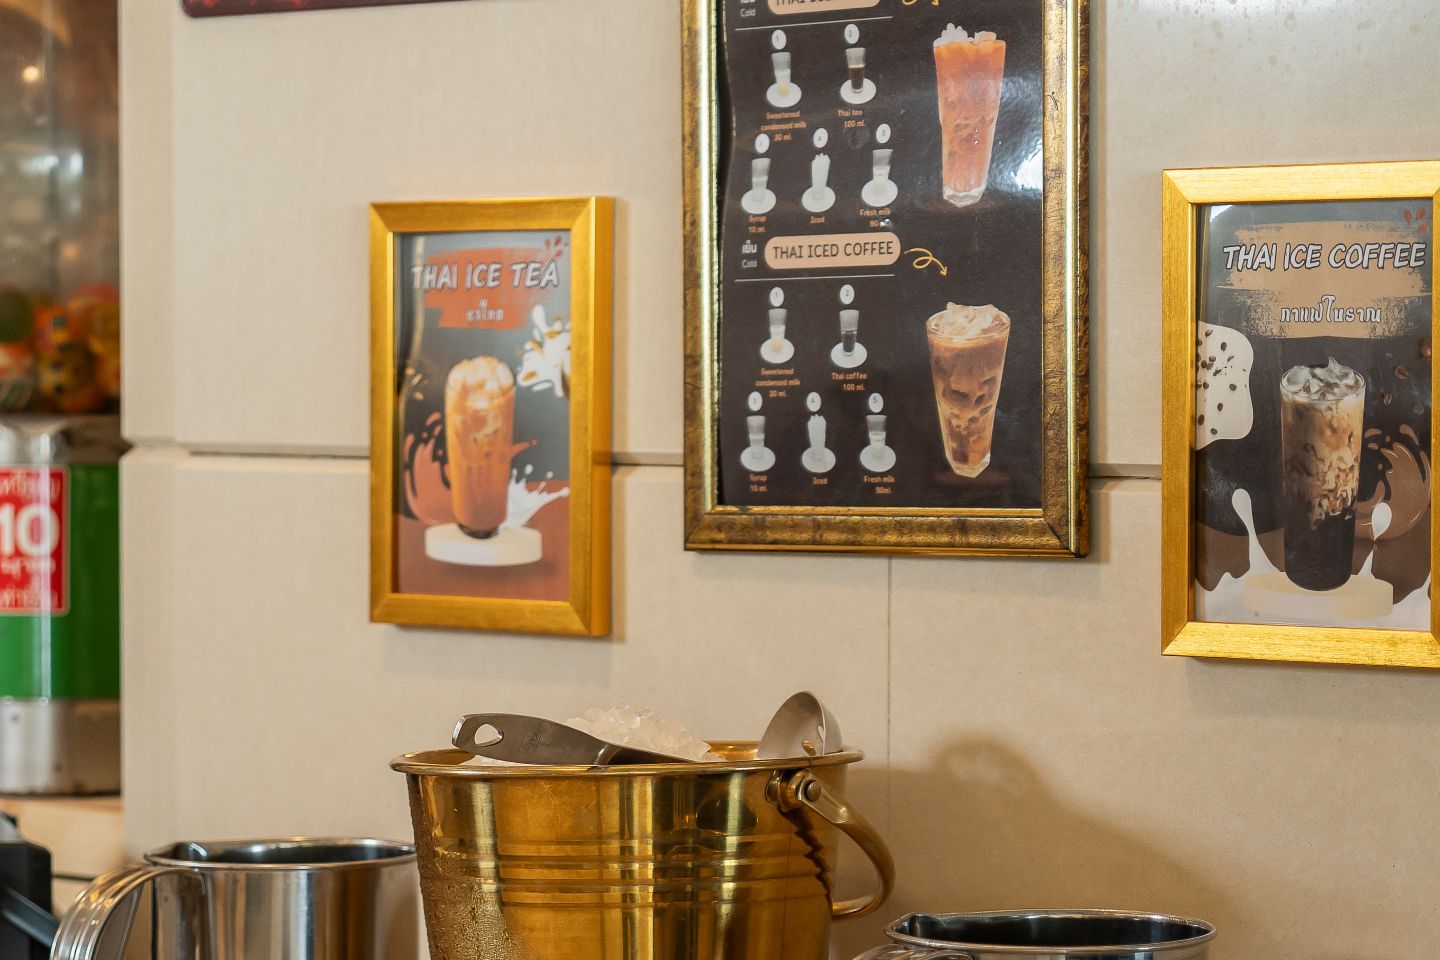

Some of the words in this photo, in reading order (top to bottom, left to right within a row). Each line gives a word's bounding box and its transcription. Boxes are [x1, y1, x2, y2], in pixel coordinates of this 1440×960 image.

[860, 208, 878, 217] Fresh
[879, 208, 891, 216] milk
[811, 216, 825, 224] Iced
[773, 245, 803, 259] THAI
[808, 243, 839, 258] ICED
[844, 241, 894, 256] COFFEE
[1223, 243, 1277, 271] THAI
[1283, 243, 1322, 271] ICE
[1328, 243, 1427, 270] COFFEE
[741, 259, 757, 268] Cold
[411, 262, 459, 290] THAI
[465, 261, 504, 290] ICE
[511, 260, 561, 289] TEA
[1280, 295, 1382, 323] กาแฟโบราณ
[832, 372, 845, 380] Thai
[846, 372, 868, 380] coffee
[864, 475, 881, 483] Fresh
[882, 475, 895, 483] milk
